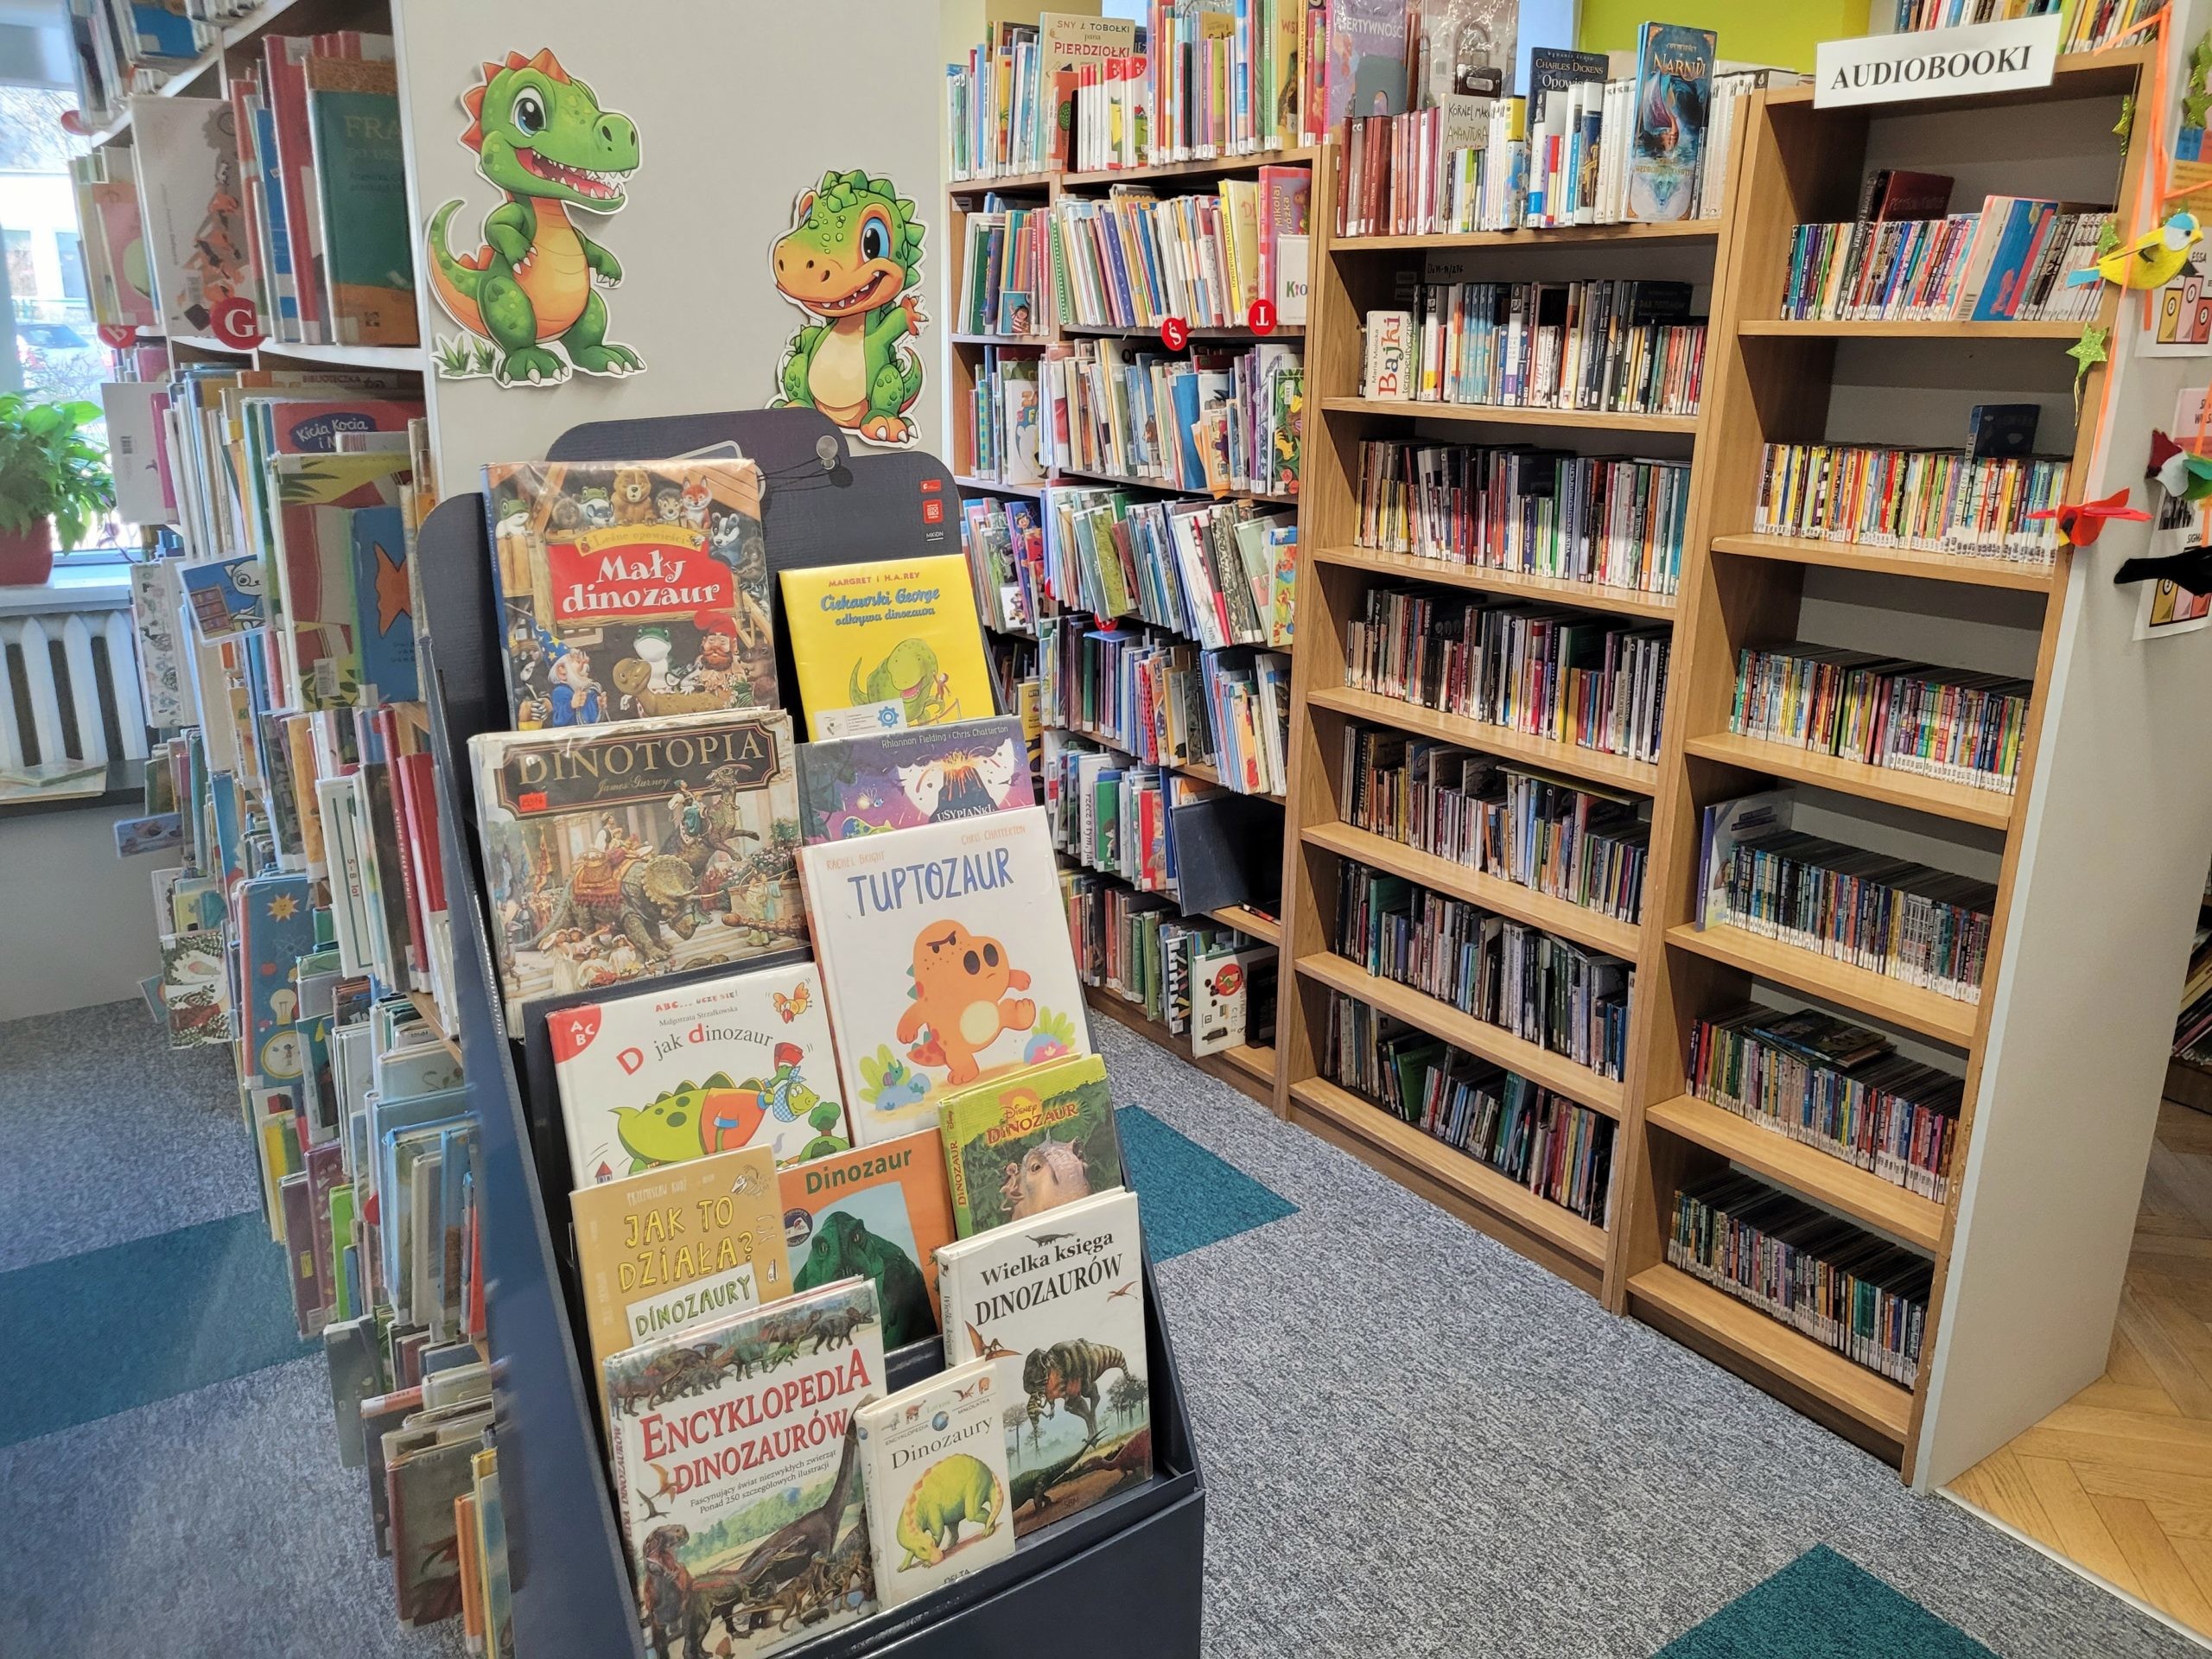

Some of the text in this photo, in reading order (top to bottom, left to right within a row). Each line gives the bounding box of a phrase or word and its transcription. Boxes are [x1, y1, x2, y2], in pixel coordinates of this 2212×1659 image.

[1057, 20, 1077, 29] SNY
[1090, 22, 1130, 34] TOBOŁKI
[1084, 34, 1101, 42] pana
[1054, 41, 1130, 58] PIERDZIOŁKI
[1535, 59, 1604, 75] CHARLES DICKENS
[1831, 45, 2033, 91] AUDIOBOOKI
[1447, 103, 1473, 122] KORNEL
[1446, 125, 1488, 145] AWANTURA
[225, 308, 256, 337] G
[1378, 315, 1404, 397] Bajki
[296, 417, 369, 442] Kicia Kocia
[595, 549, 687, 584] Mały
[828, 575, 872, 588] MARGRET
[562, 582, 721, 613] dinozaur
[820, 587, 941, 612] Ciekawski George
[518, 729, 765, 785] DINOTOPIA
[881, 725, 1009, 748] Rhiannon Fielding Chris Chatterton
[593, 774, 671, 799] James Gurney
[847, 847, 1014, 917] TUPTOZAUR
[616, 1022, 774, 1076] D jak dinozaur
[986, 1103, 1079, 1146] DINOZAUR
[805, 1147, 913, 1195] Dinozaur
[950, 1141, 967, 1206] DINOZAUR
[624, 1195, 734, 1249] JAK TO
[980, 1231, 1115, 1287] Wielka księga
[635, 1274, 752, 1337] DINOZAURY
[975, 1253, 1123, 1326] DINOZAURÓW
[639, 1347, 872, 1463] ENCYKLOPEDIA
[673, 1408, 849, 1495] DINOZAURÓW
[885, 1424, 929, 1446] ENCYKLOPEDIA
[892, 1416, 993, 1471] Dinozaury
[690, 1484, 736, 1508] Fascynujący
[736, 1477, 759, 1491] świat
[759, 1459, 805, 1483] niezwykłych
[700, 1460, 830, 1514] Ponad 250 szczegółowych ilustracji
